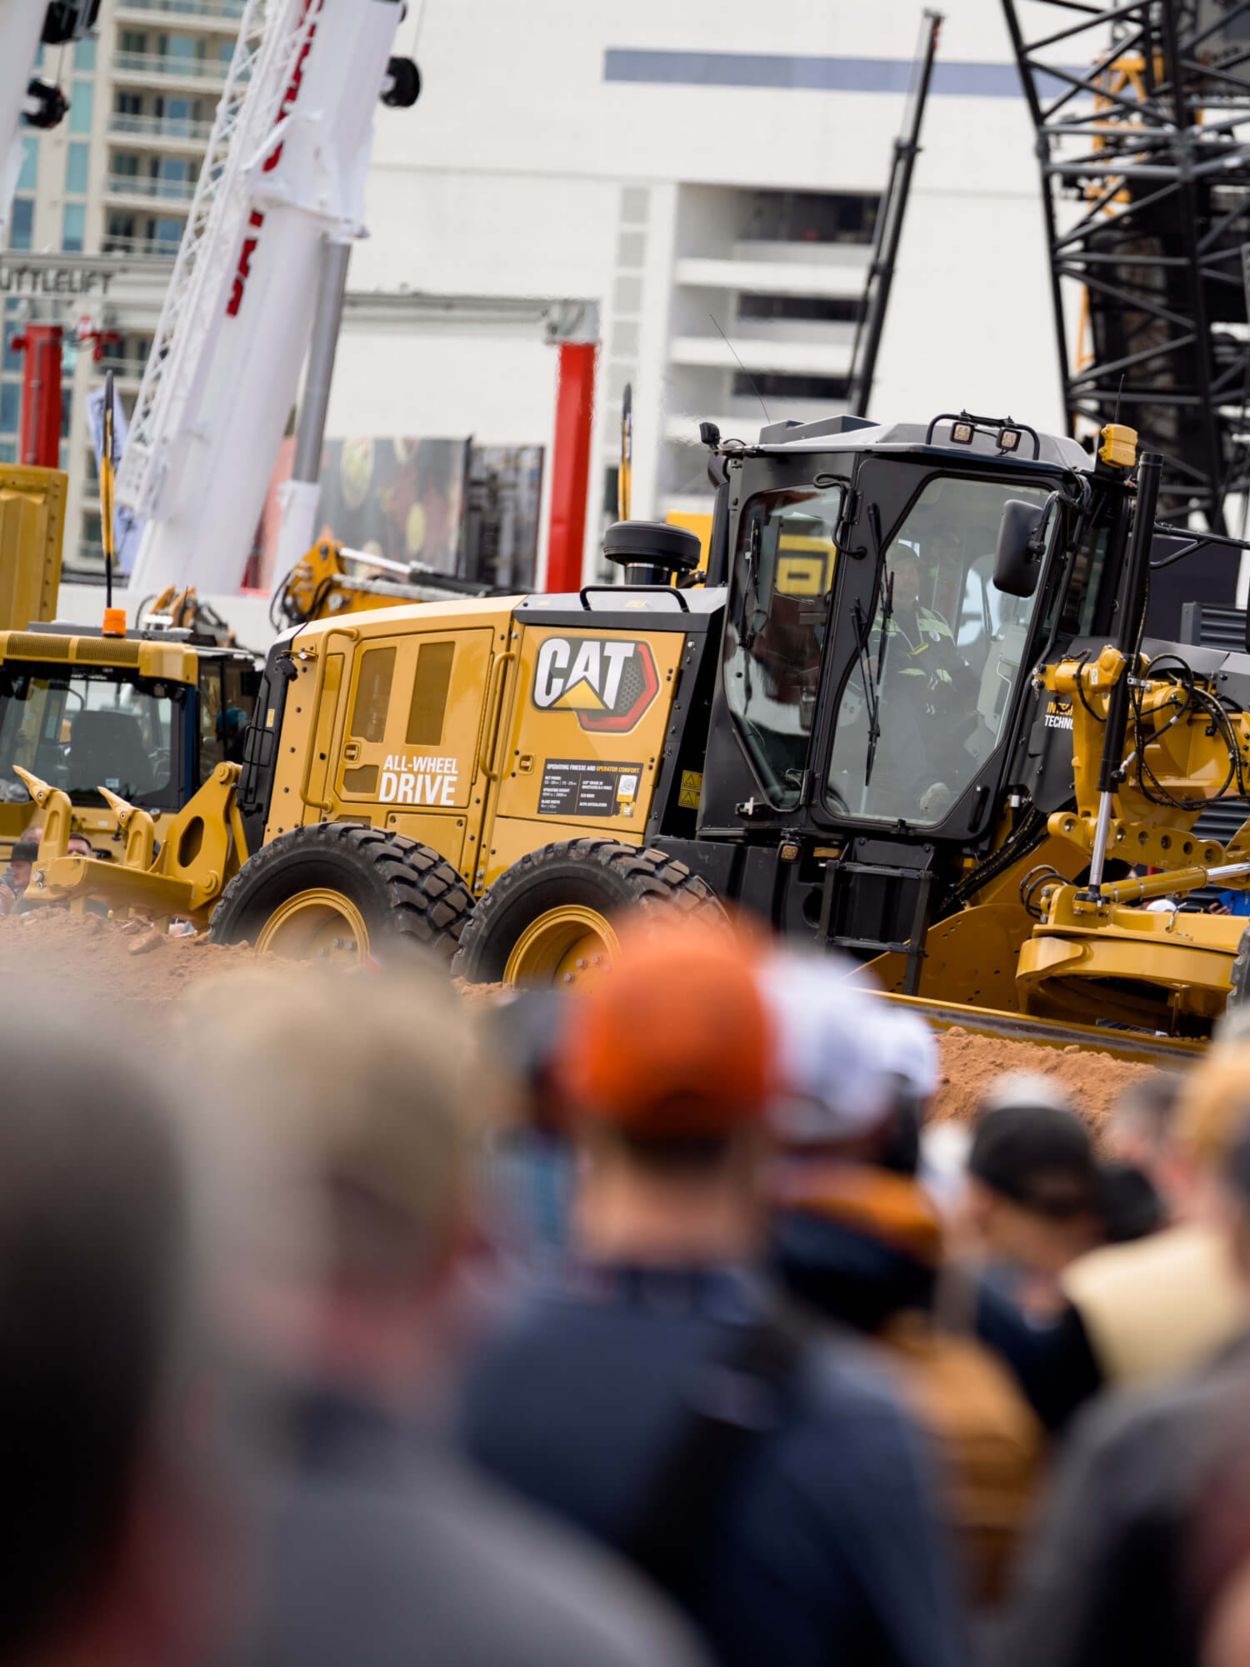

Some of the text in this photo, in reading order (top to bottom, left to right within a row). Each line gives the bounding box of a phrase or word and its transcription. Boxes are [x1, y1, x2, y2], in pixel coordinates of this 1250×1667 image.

[534, 638, 636, 710] CAT
[383, 754, 459, 774] ALL-WHEEL
[379, 771, 458, 806] DRIVE
